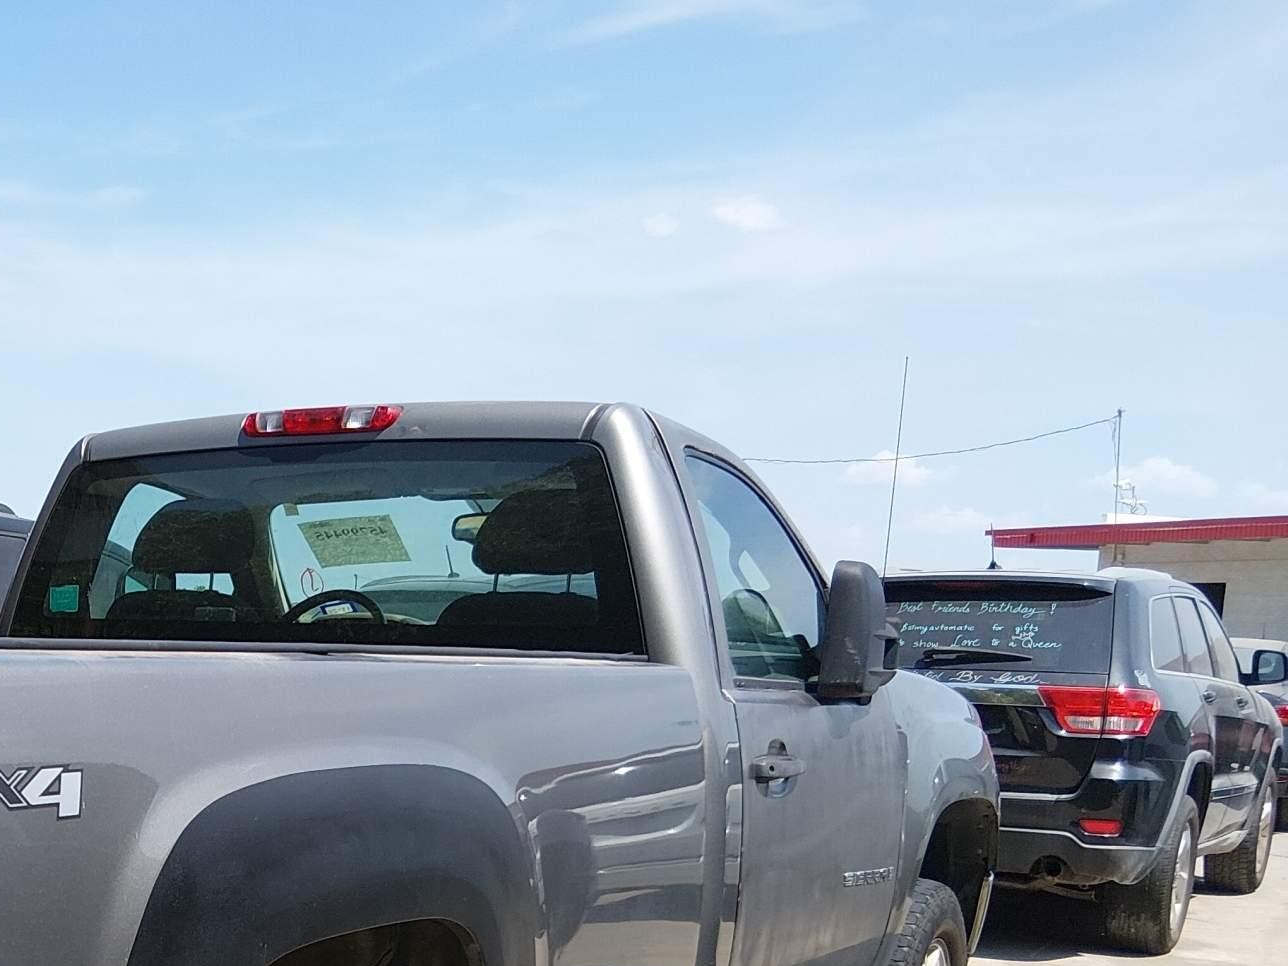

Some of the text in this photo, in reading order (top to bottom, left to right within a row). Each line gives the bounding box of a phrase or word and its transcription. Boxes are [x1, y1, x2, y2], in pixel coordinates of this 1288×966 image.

[896, 601, 924, 614] Best
[978, 602, 1046, 618] Birthday
[1015, 623, 1039, 634] gifts
[913, 639, 939, 648] show
[951, 634, 981, 647] Love
[1021, 636, 1062, 649] Queen
[951, 671, 983, 683] By
[991, 672, 1040, 684] God
